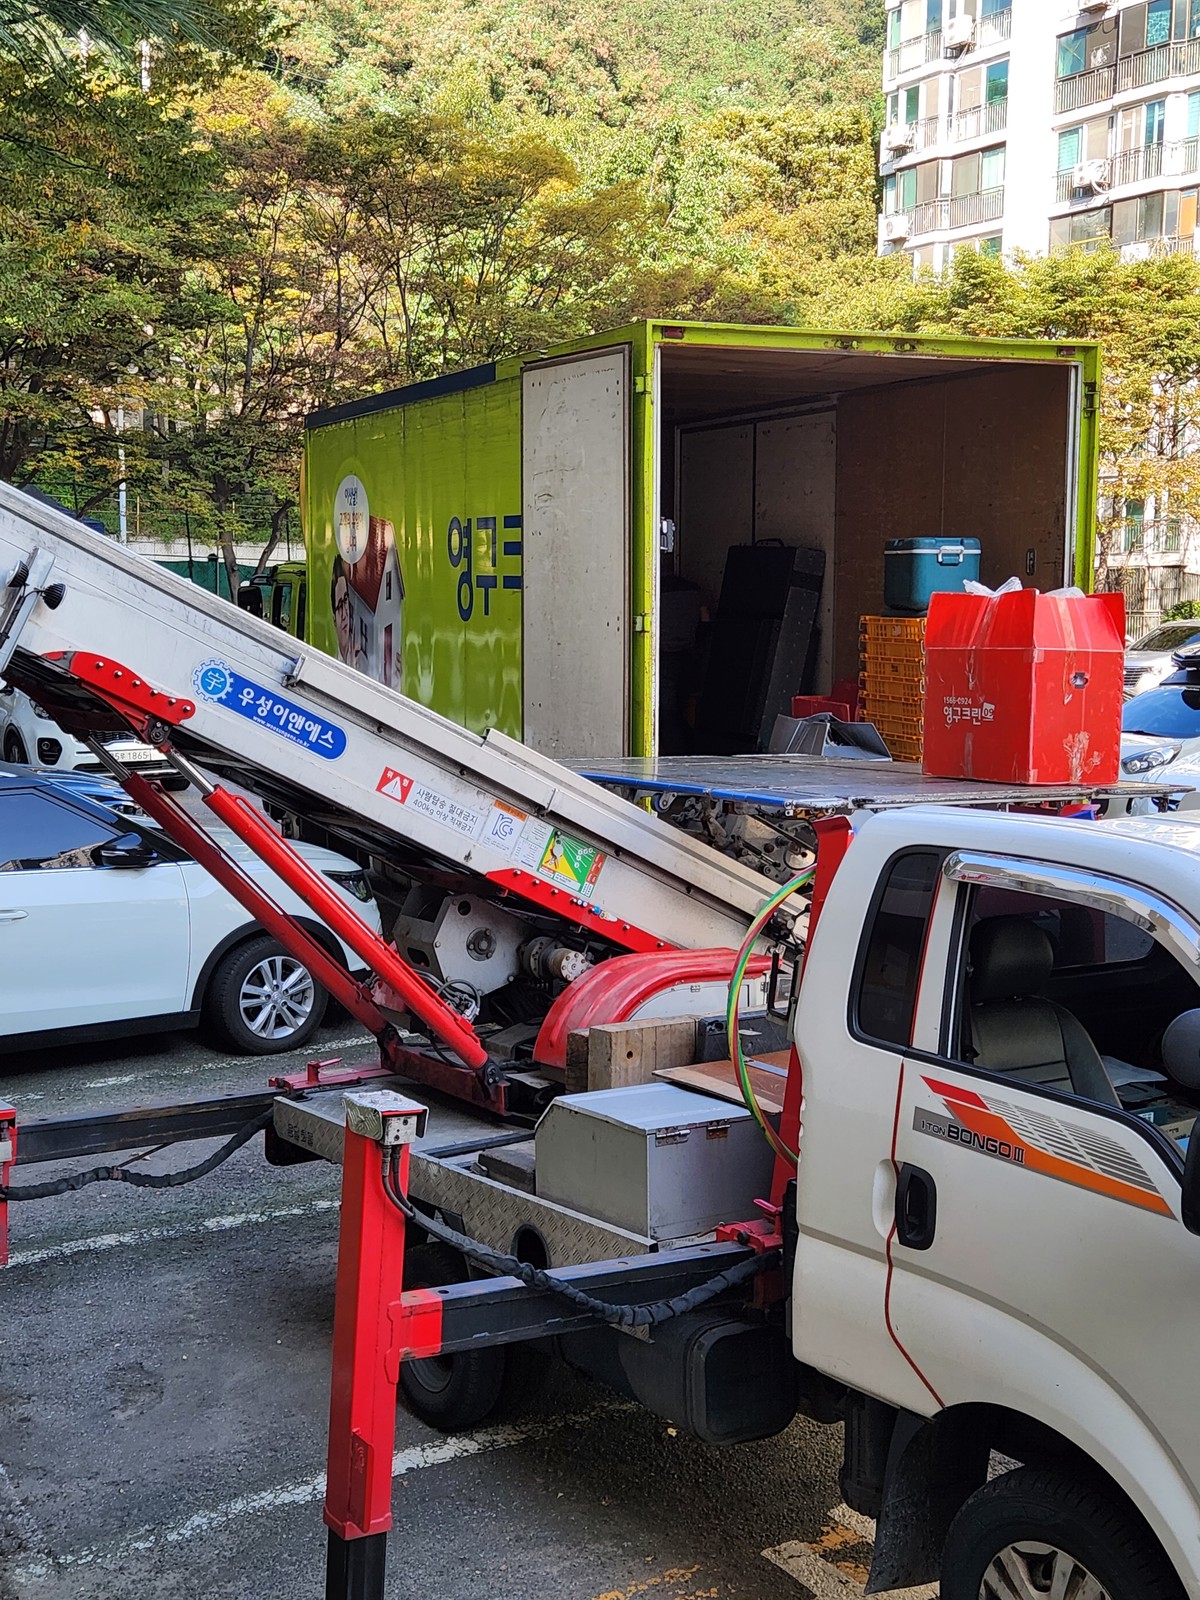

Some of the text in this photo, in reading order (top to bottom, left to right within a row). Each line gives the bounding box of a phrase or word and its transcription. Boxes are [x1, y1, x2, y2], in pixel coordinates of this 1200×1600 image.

[238, 687, 335, 749] 우성이앤에스
[127, 751, 149, 760] 1865
[412, 798, 435, 816] 400kg
[435, 810, 449, 822] 이상
[416, 788, 446, 810] 사람탑승
[448, 803, 479, 825] 절대금지
[927, 1122, 946, 1136] TON
[947, 1123, 1012, 1159] BONGO
